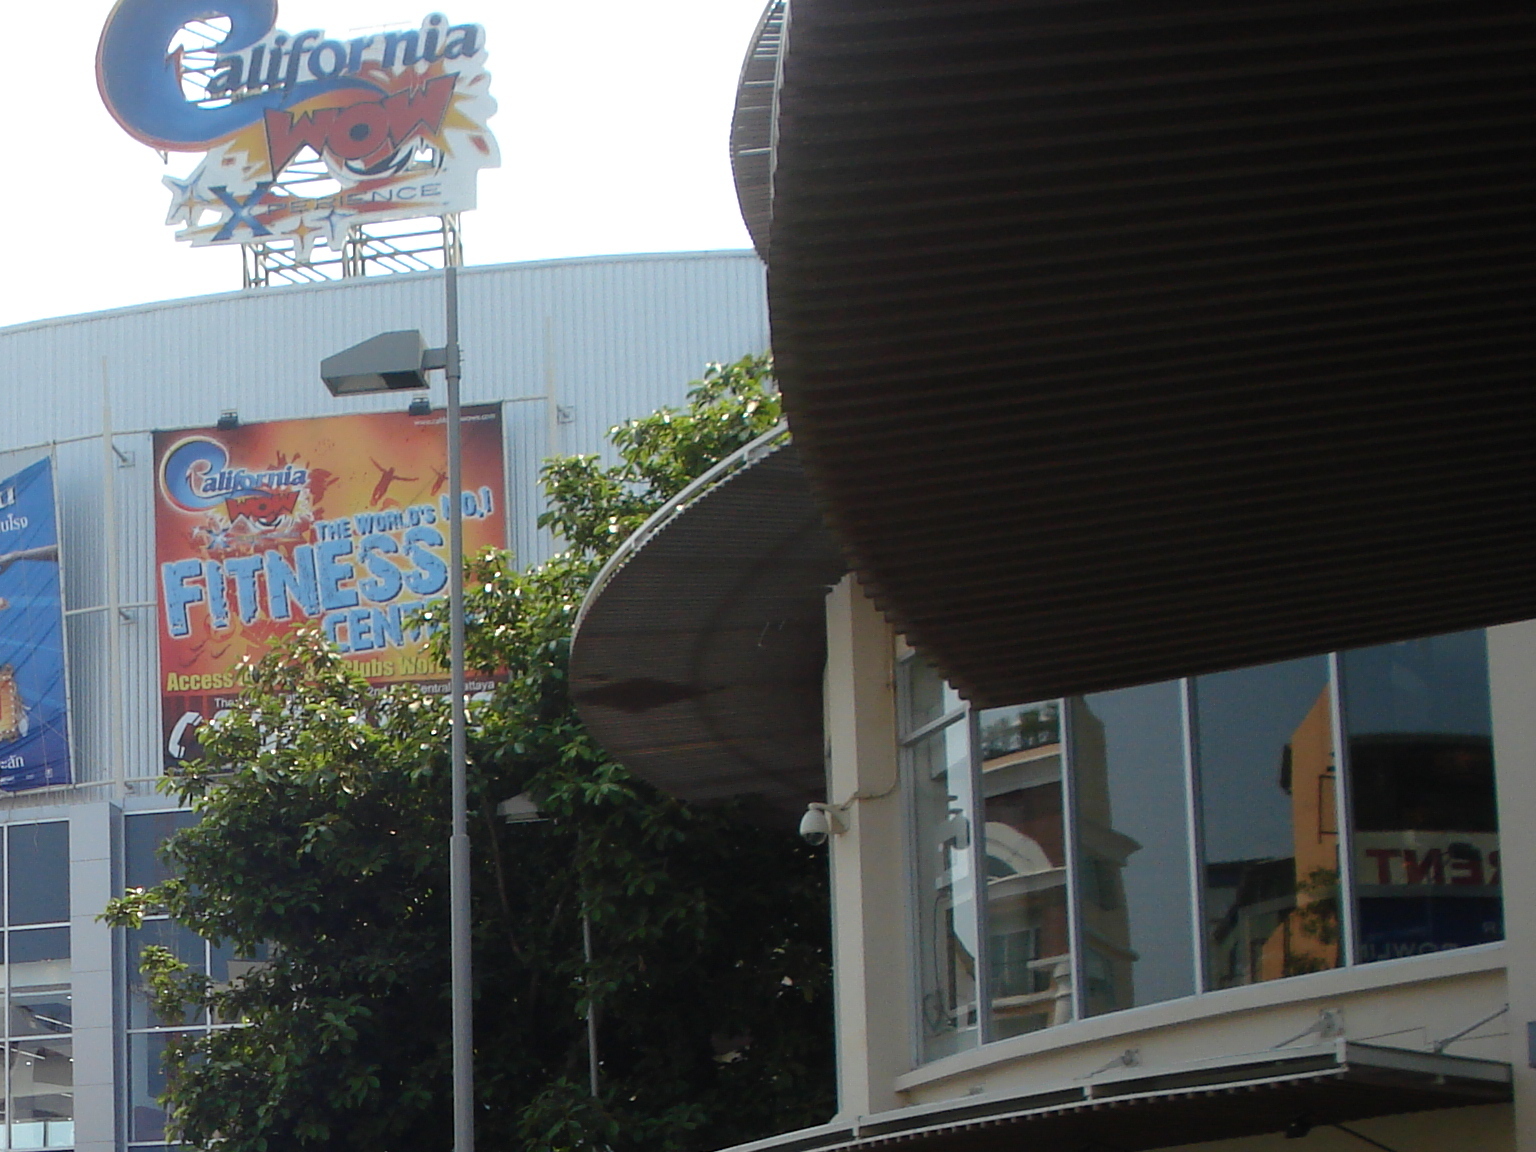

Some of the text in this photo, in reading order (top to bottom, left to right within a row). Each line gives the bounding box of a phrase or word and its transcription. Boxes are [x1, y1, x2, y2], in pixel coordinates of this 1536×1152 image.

[96, 0, 481, 151] California
[263, 72, 461, 182] WOW
[161, 438, 307, 511] California
[225, 490, 301, 525] WOW
[316, 519, 352, 541] THE
[355, 505, 436, 536] WORLD'S
[163, 526, 449, 638] FITNESS
[167, 672, 233, 692] Access
[464, 680, 495, 692] attaya
